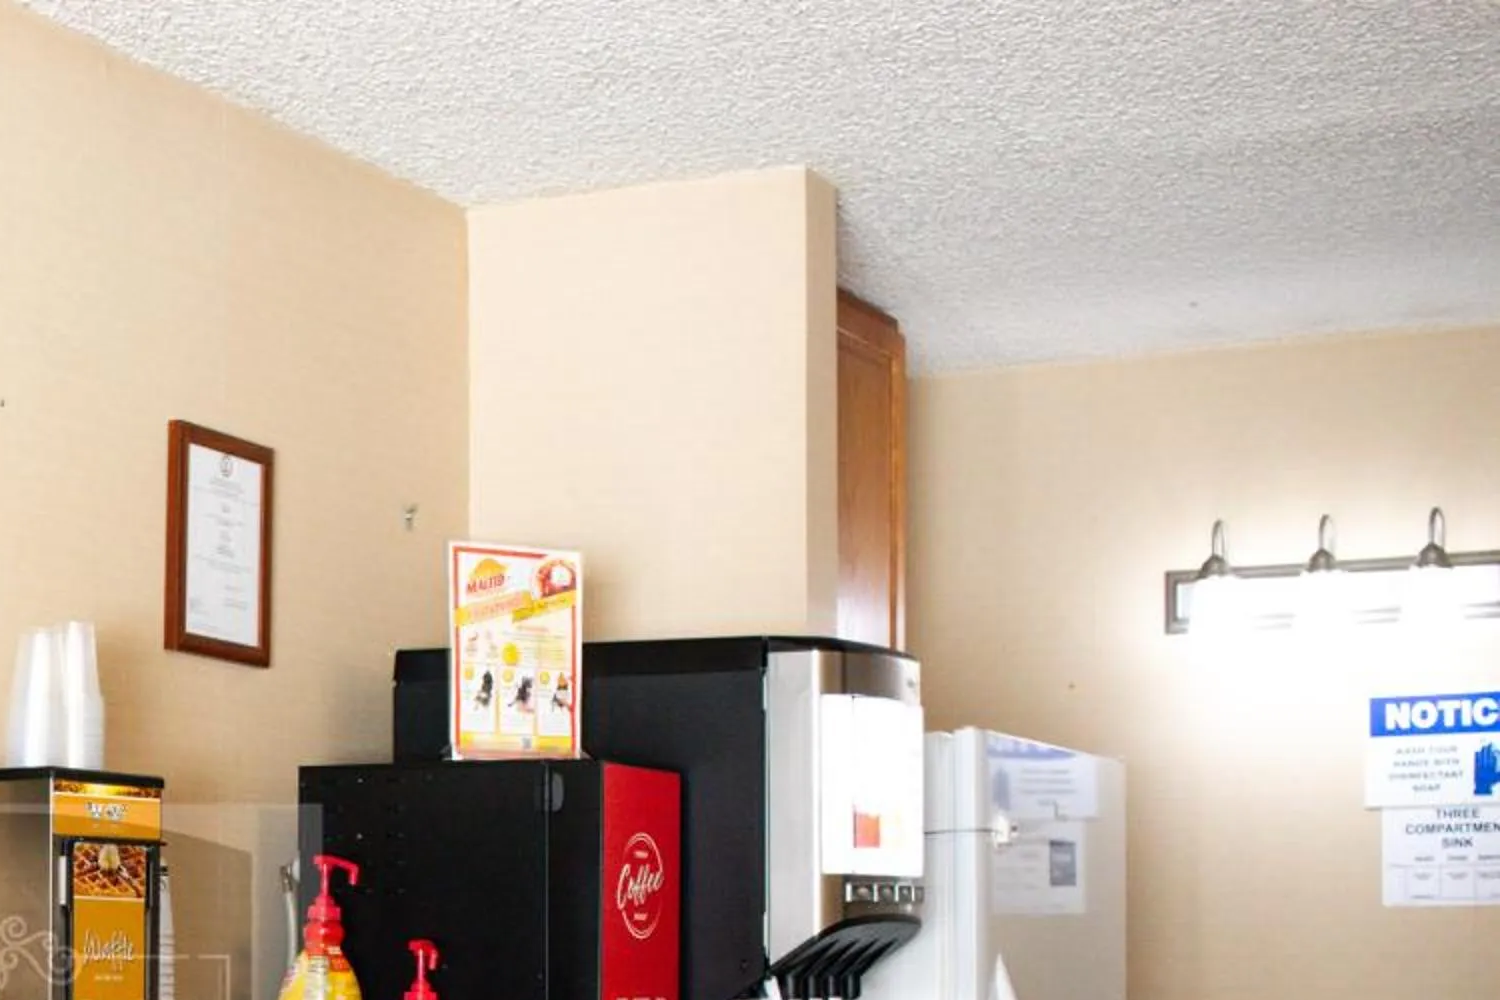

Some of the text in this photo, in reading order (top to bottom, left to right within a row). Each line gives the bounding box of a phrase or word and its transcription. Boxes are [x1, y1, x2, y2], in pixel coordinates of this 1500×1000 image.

[1436, 807, 1480, 819] THREE
[1441, 836, 1474, 849] SINK
[616, 863, 665, 911] Coffee
[83, 927, 133, 972] Waffle
